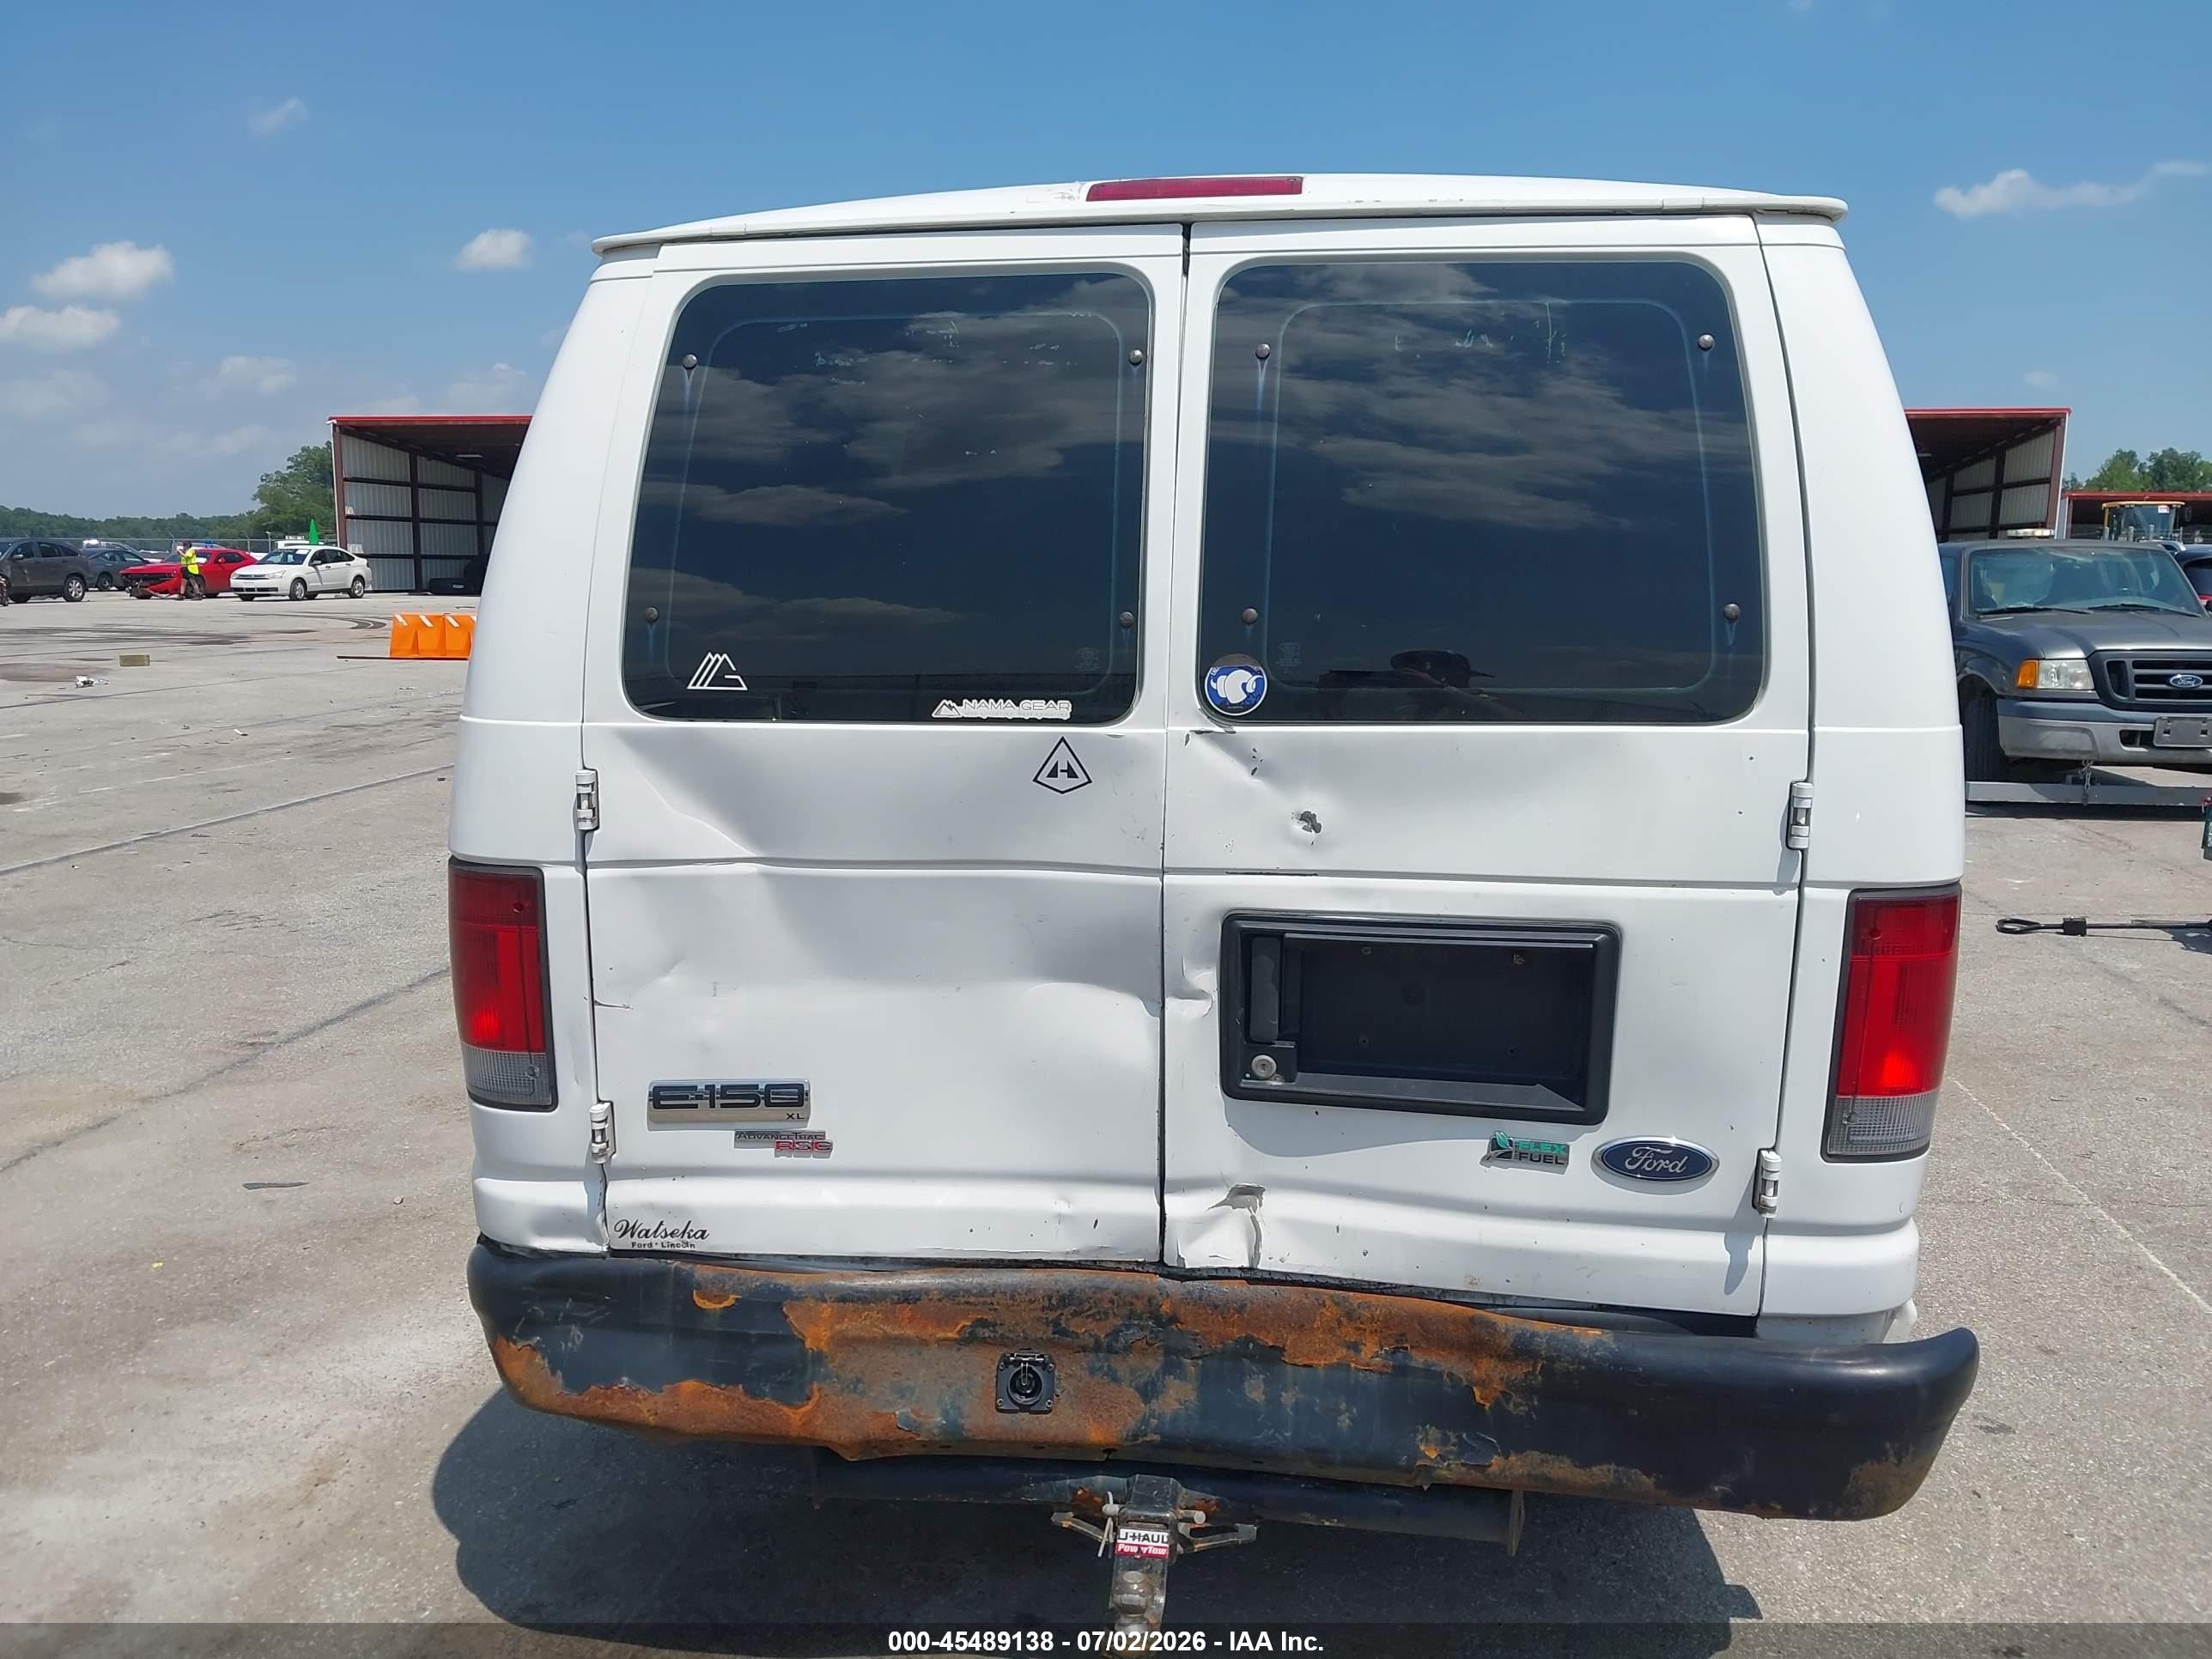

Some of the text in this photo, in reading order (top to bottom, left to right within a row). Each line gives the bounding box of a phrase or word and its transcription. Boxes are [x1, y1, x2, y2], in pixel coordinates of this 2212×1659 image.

[964, 700, 1070, 712] NAMA GEAR
[775, 1139, 832, 1152] RSC
[1519, 1140, 1566, 1155] FLEX
[1519, 1152, 1565, 1165] FUEL
[1625, 1147, 1688, 1173] Ford
[614, 1219, 710, 1240] Watseka
